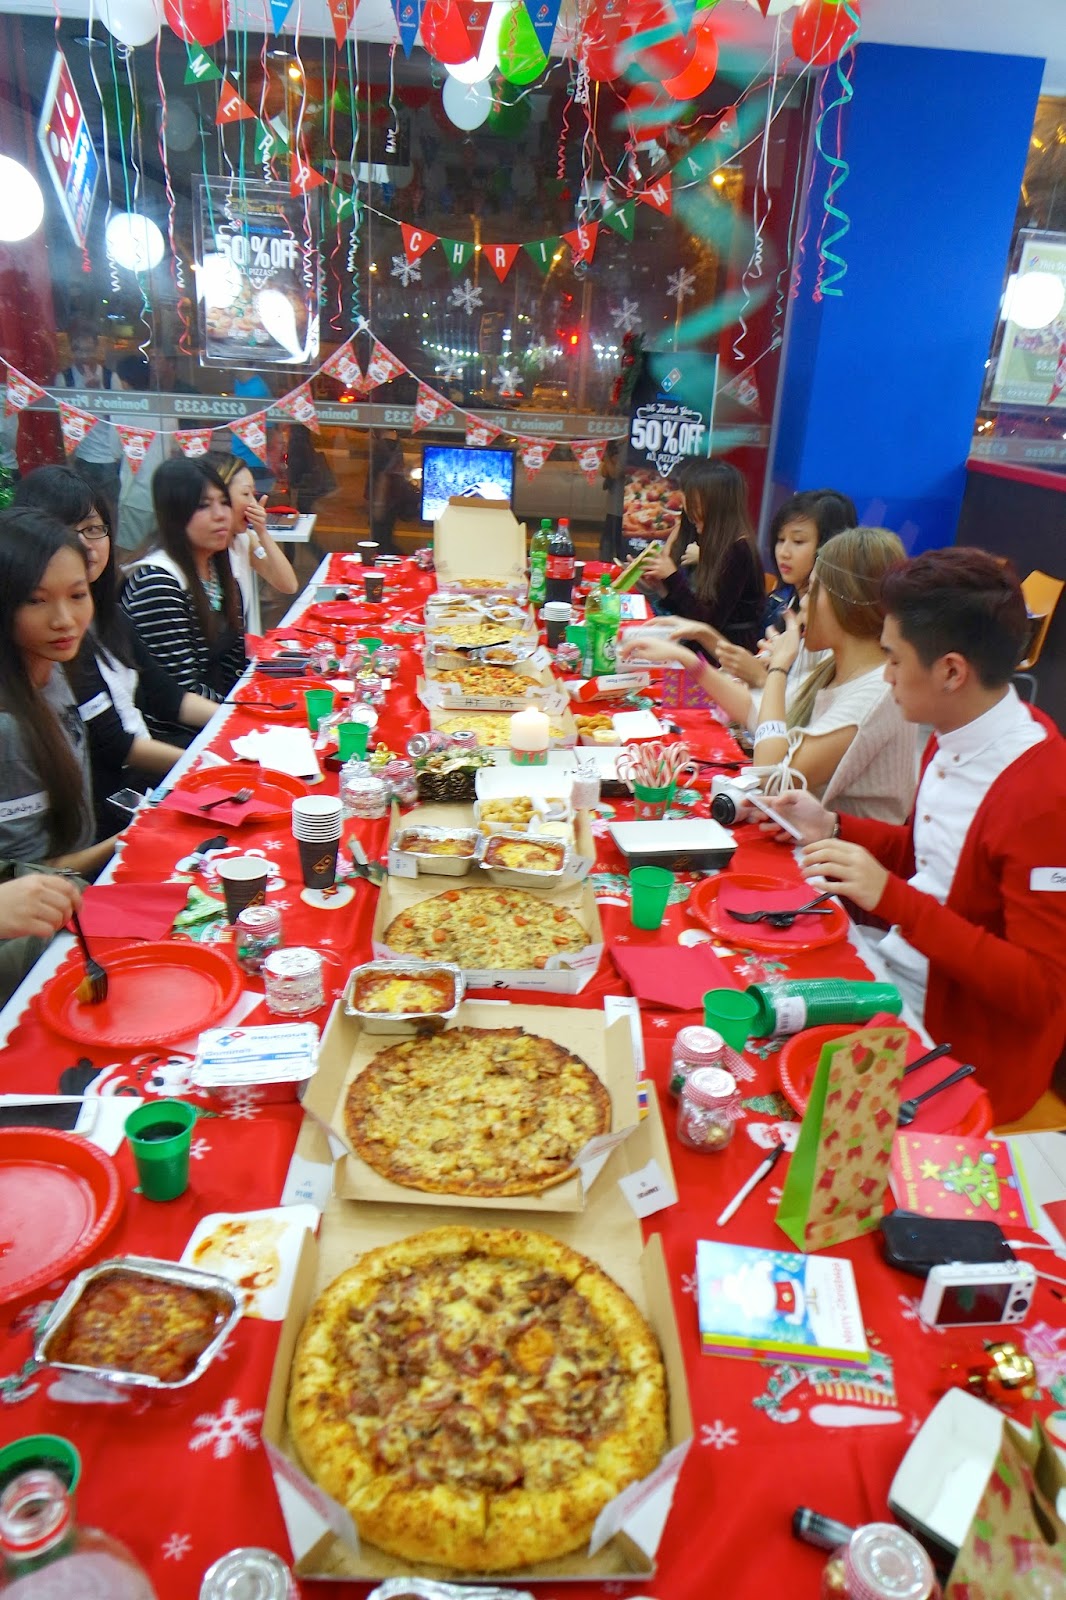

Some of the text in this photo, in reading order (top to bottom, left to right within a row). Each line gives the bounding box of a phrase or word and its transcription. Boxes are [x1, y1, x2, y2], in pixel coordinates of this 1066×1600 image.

[270, 238, 300, 270] OFF
[630, 418, 679, 455] 50%
[679, 424, 706, 457] OFF
